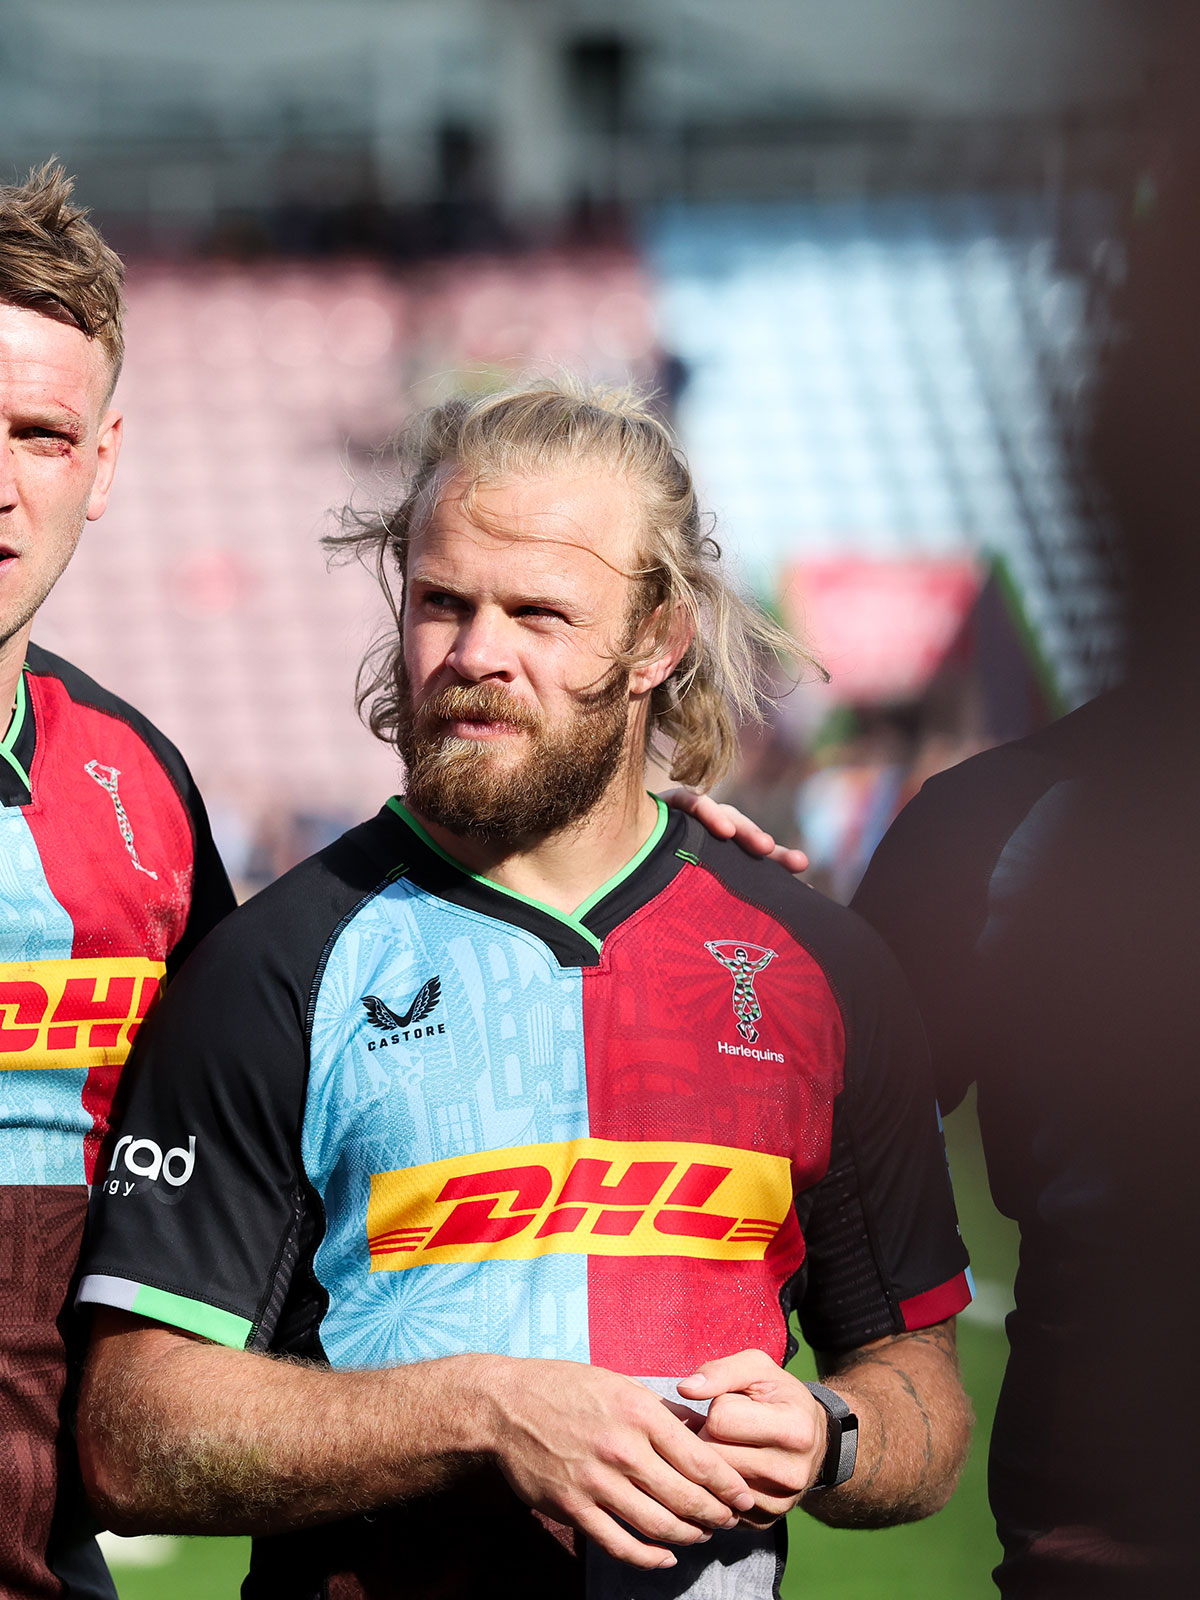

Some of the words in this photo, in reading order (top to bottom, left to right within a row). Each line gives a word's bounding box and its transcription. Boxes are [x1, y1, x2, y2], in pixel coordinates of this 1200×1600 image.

[368, 1024, 445, 1051] CASTORE
[717, 1041, 785, 1063] Harlequins
[423, 1158, 740, 1251] DHL
